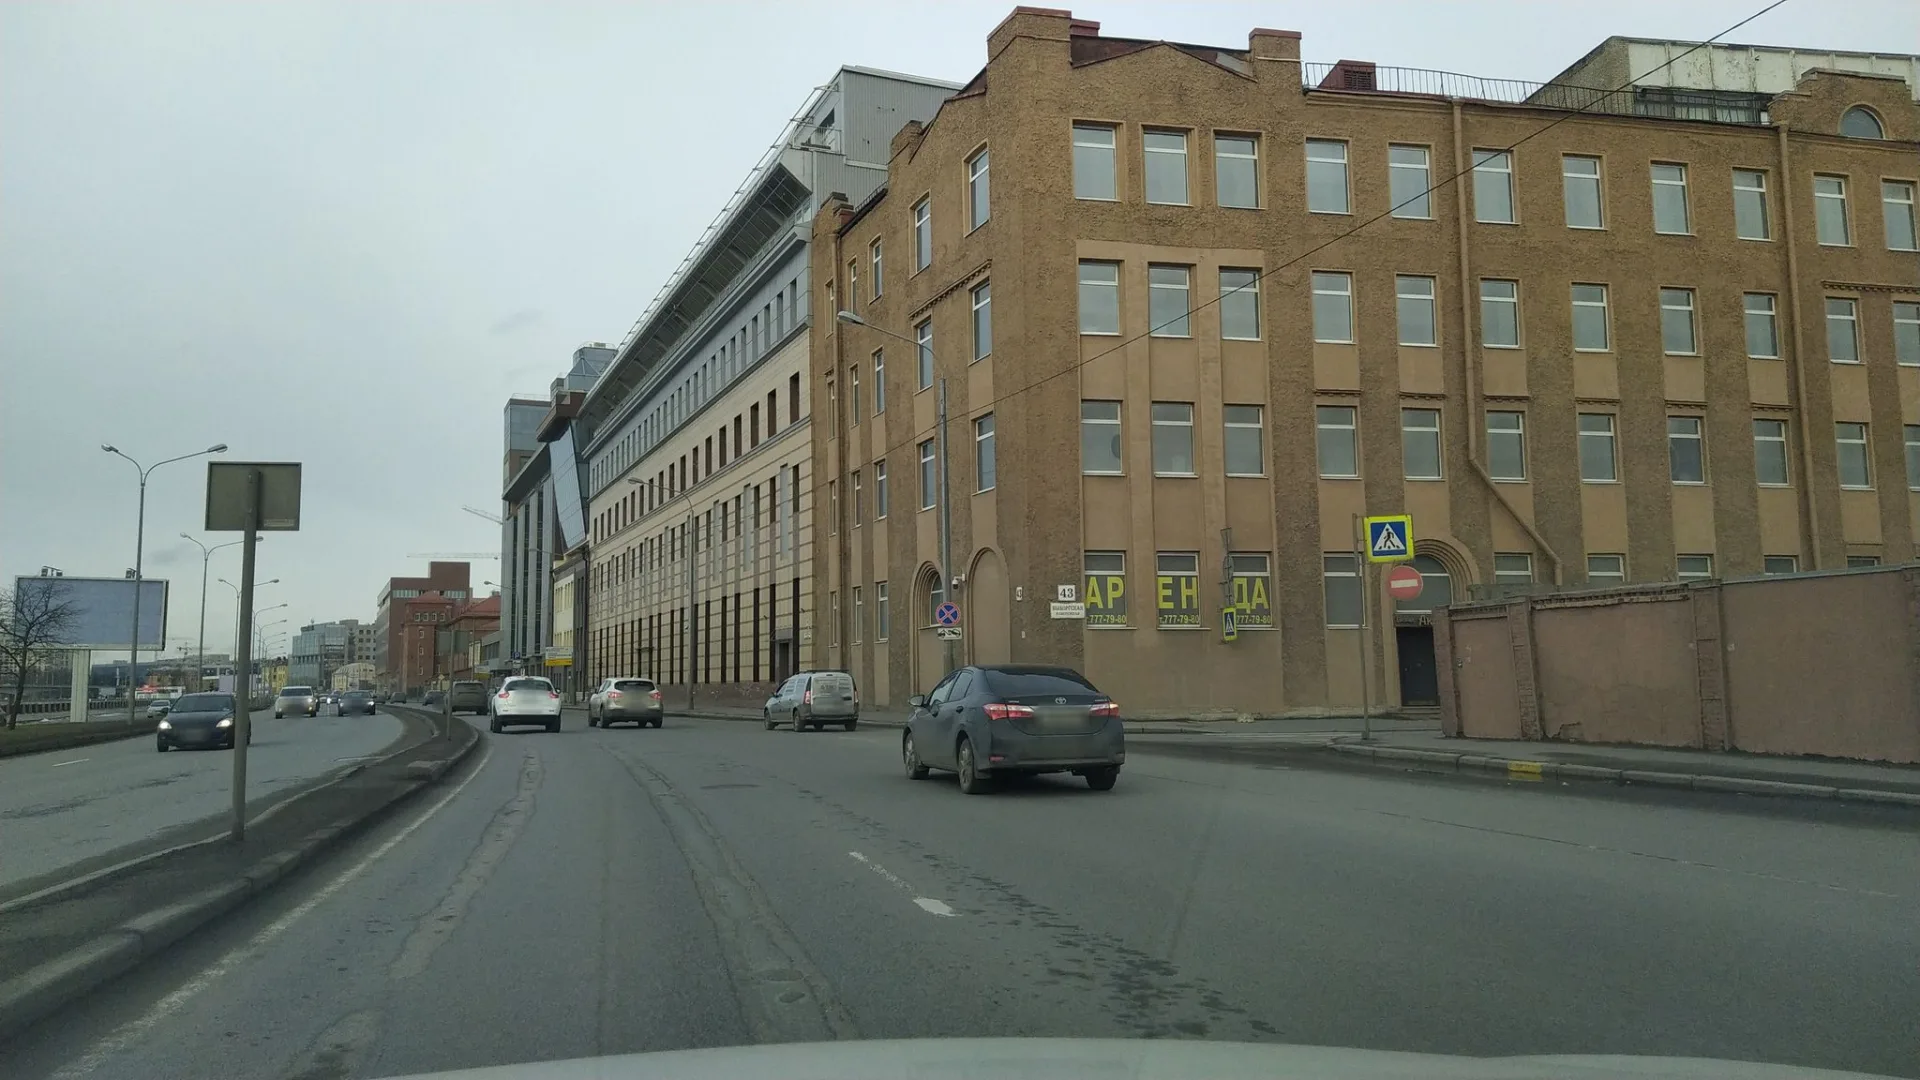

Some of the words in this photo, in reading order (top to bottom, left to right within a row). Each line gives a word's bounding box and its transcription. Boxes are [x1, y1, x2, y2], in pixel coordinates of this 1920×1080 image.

[1059, 588, 1074, 598] 43
[1086, 576, 1124, 609] АР
[1158, 576, 1198, 609] ЕН
[1233, 577, 1269, 614] ДА
